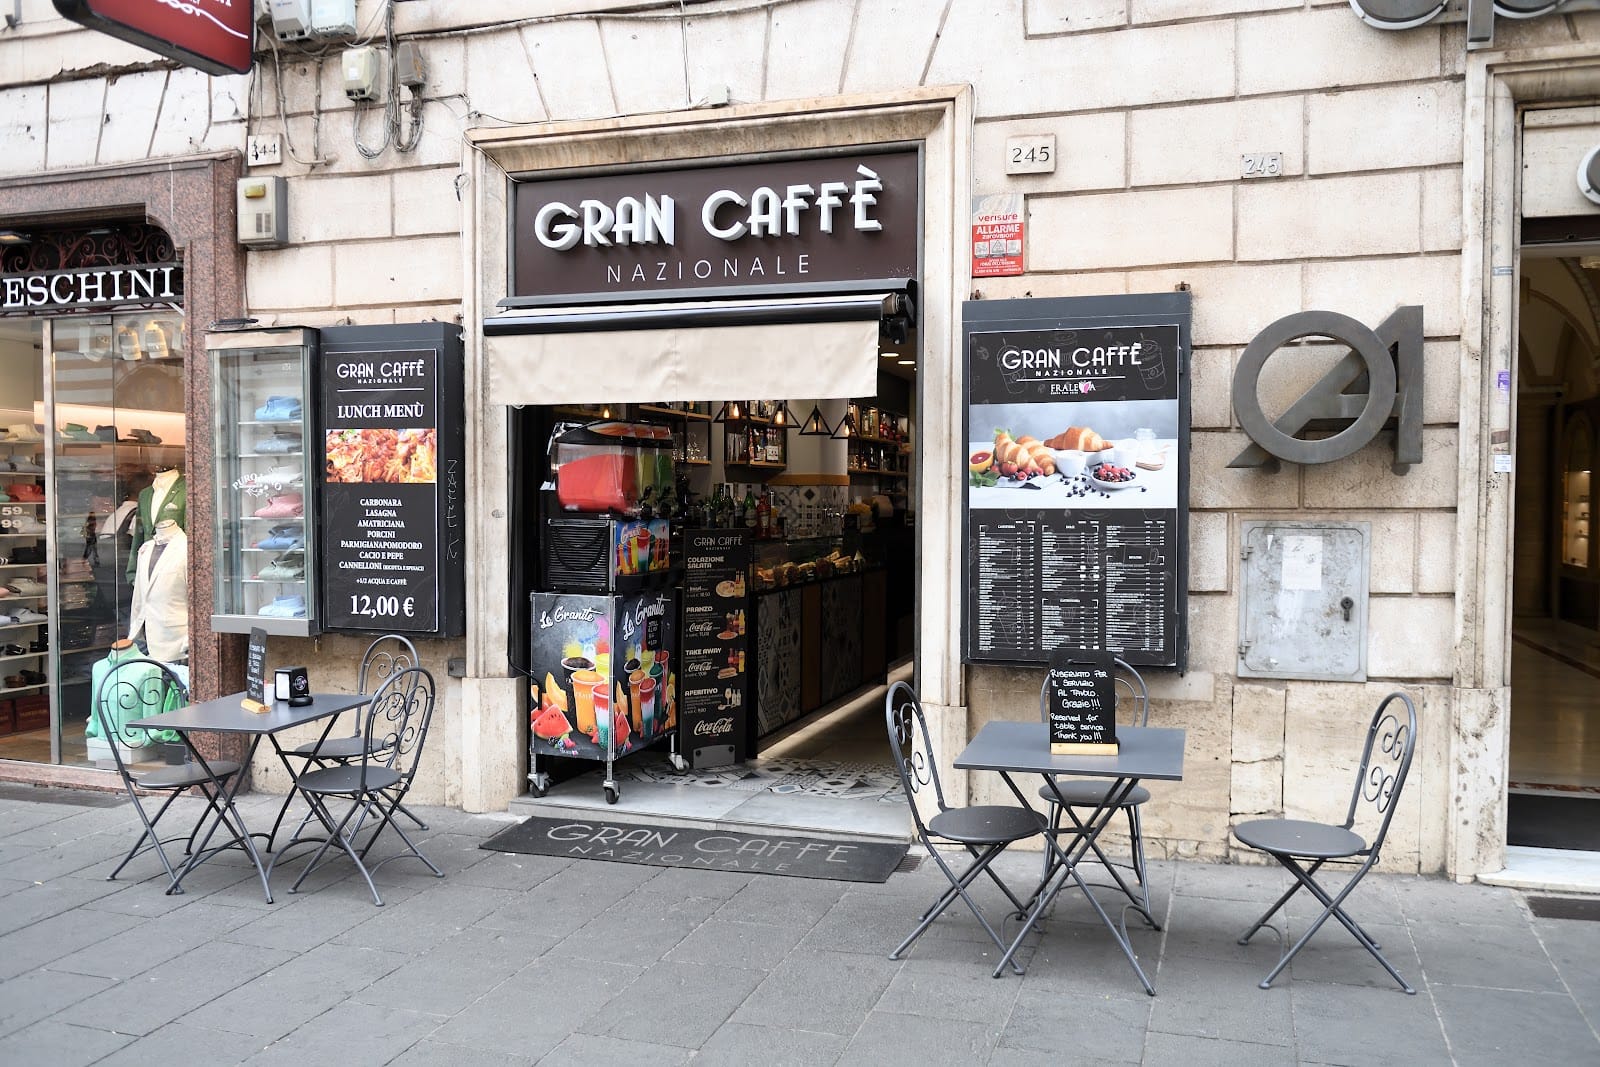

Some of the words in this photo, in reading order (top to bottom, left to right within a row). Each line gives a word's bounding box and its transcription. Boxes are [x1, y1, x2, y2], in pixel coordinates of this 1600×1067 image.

[1012, 146, 1050, 163] 245
[1245, 157, 1278, 175] 245
[534, 191, 675, 251] GRAN
[701, 164, 883, 241] CAFFÈ
[978, 213, 1018, 222] verisure
[976, 223, 1020, 235] ALLARME
[606, 254, 809, 284] NAZIONALE
[0, 267, 175, 309] ESCHINI
[1001, 348, 1061, 370] GRAN
[1071, 342, 1142, 367] CAFFÈ
[336, 362, 374, 379] GRAN
[380, 358, 425, 377] CAFFÈ
[1035, 368, 1108, 377] NAZIONALE
[337, 404, 382, 419] LUNCH
[383, 401, 425, 418] MENÙ
[359, 498, 403, 507] CARBONARA
[365, 509, 397, 517] LASAGNA
[357, 519, 406, 528] AMATRICIANA
[367, 530, 396, 539] PORCINI
[693, 536, 715, 547] GRAN
[359, 551, 381, 560] CACIO
[381, 551, 387, 560] E
[387, 552, 404, 560] PEPE
[338, 561, 382, 570] CANNELLONI
[687, 562, 712, 570] SALATA
[350, 594, 399, 619] 12,00
[402, 596, 415, 617] €
[686, 605, 714, 613] PRANZO
[685, 648, 702, 656] TAKE
[702, 647, 722, 655] AWAY
[1094, 669, 1108, 678] PER
[684, 687, 719, 697] APERITIVO
[1057, 689, 1068, 697] AL
[1050, 712, 1081, 722] Reserved
[1085, 714, 1100, 723] for
[1054, 722, 1077, 731] table
[1053, 730, 1078, 740] Thank
[547, 824, 679, 848] GRAN
[568, 845, 792, 872] NAZIONALE
